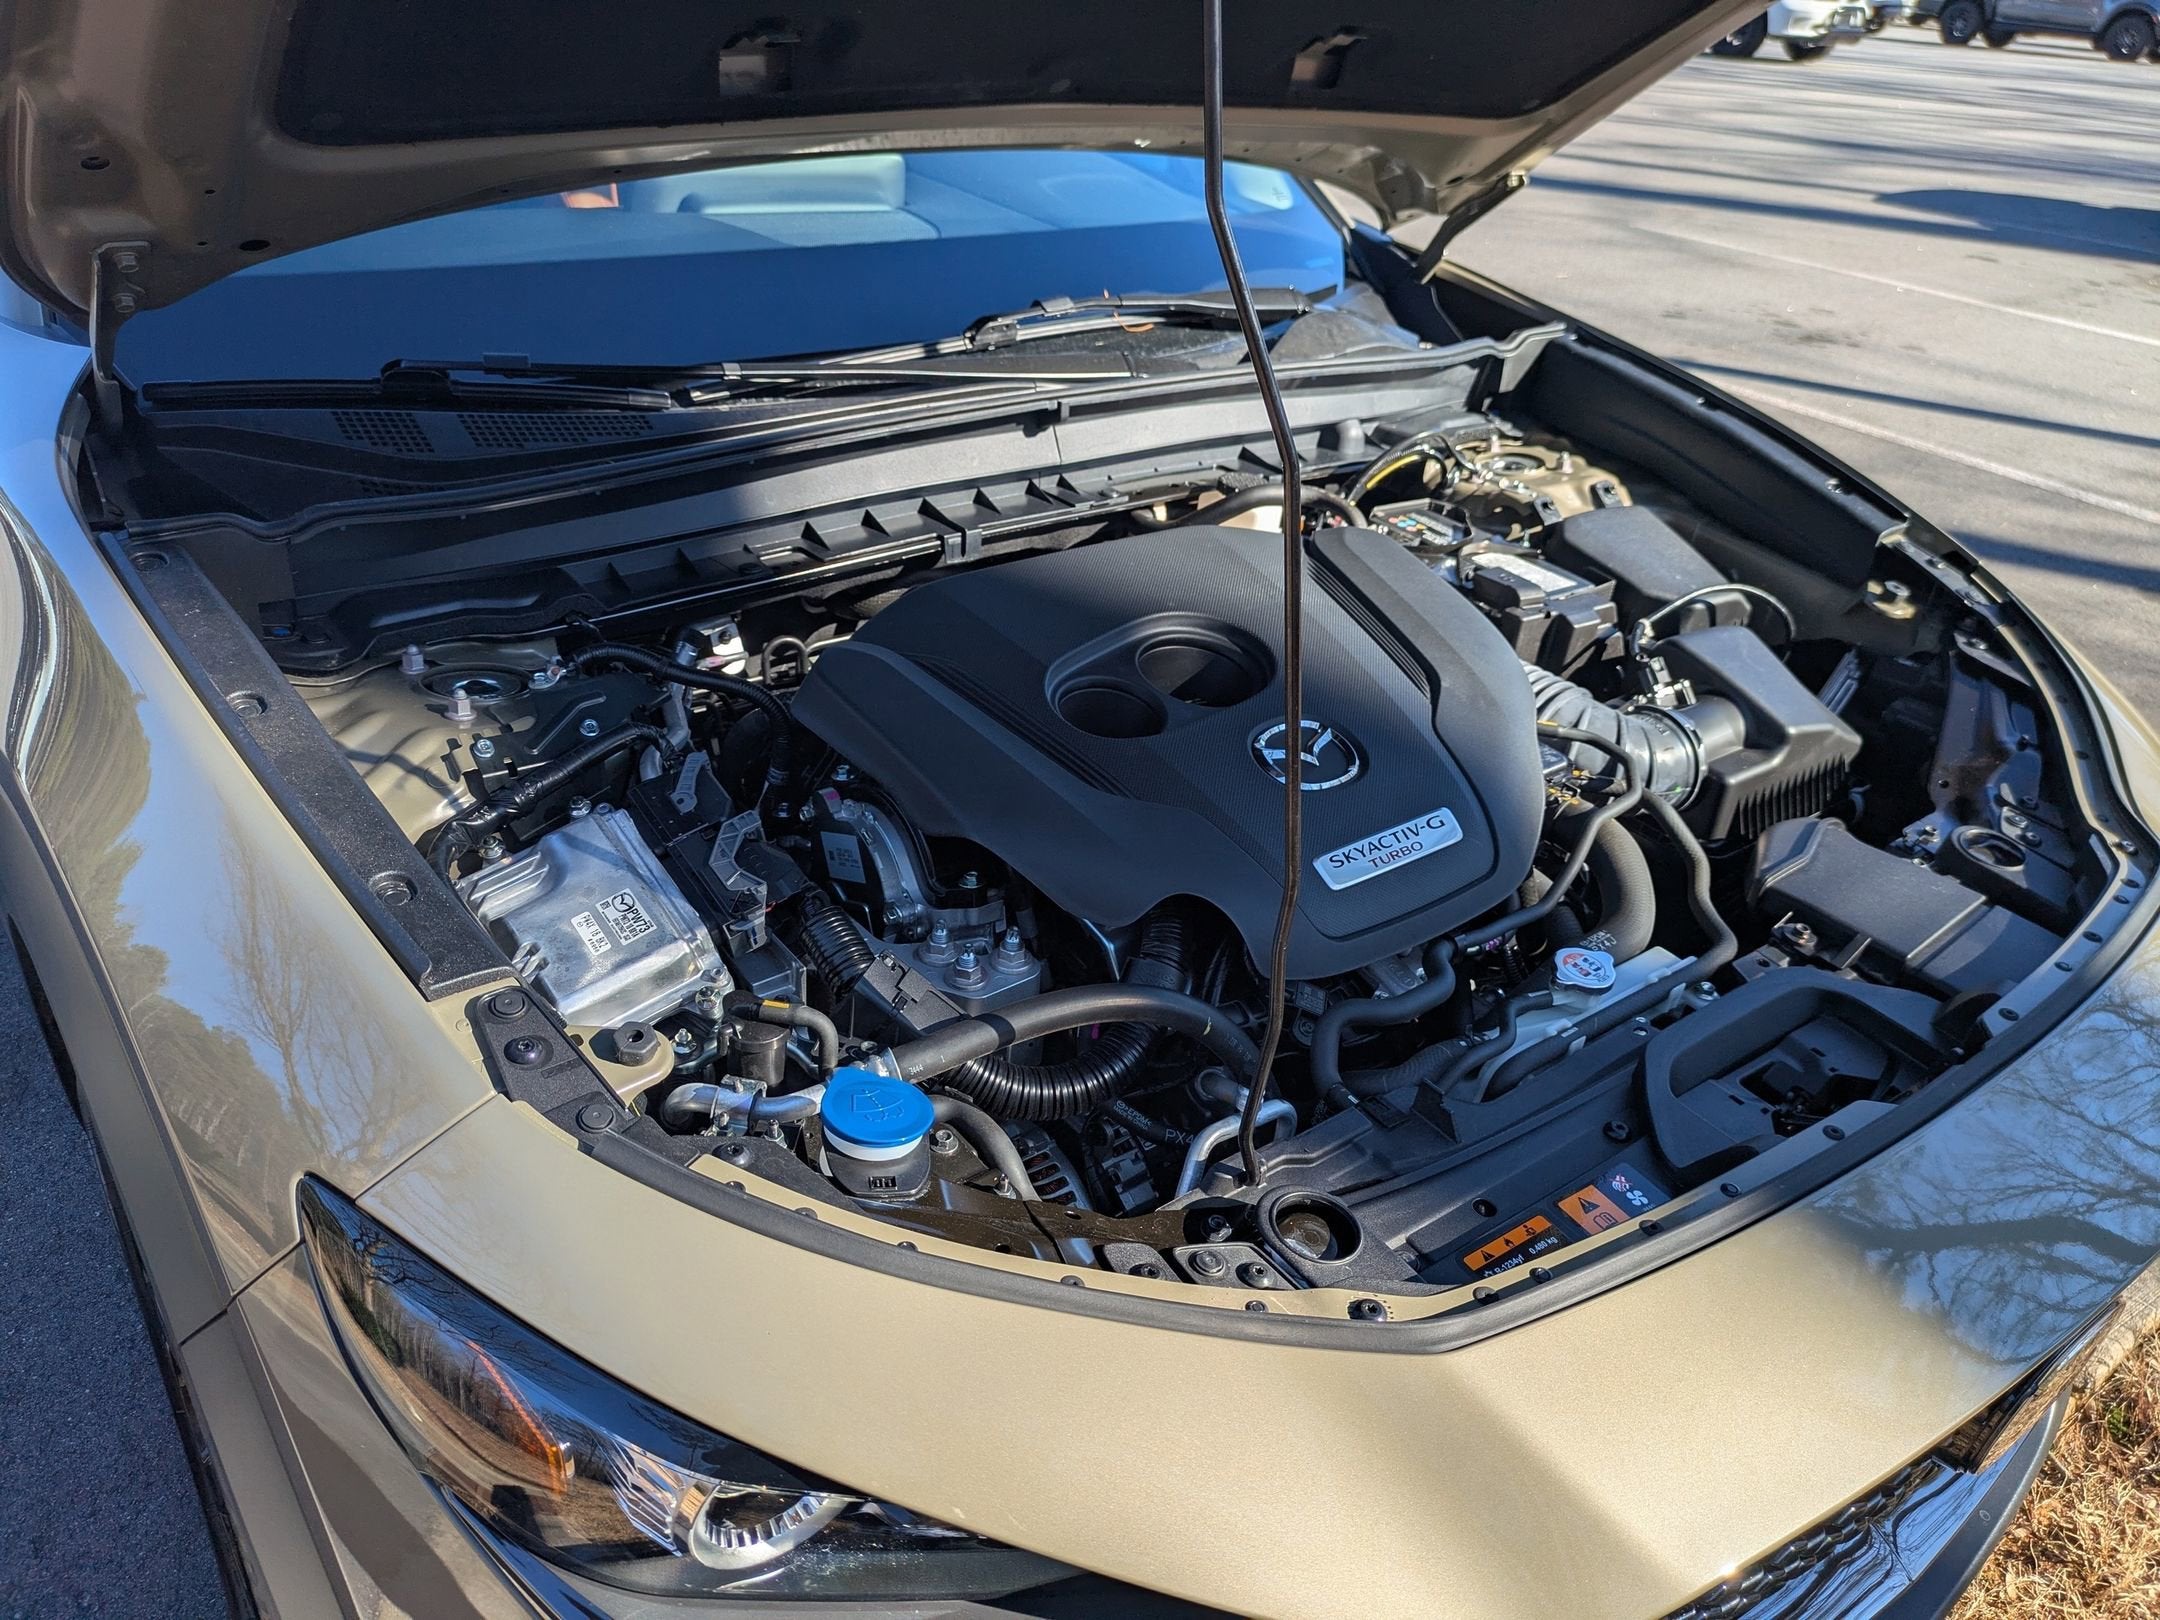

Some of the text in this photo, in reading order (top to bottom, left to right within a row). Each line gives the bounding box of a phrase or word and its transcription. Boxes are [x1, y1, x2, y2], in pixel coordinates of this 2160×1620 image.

[1328, 815, 1446, 869] SKYACTIV-G
[1368, 841, 1424, 868] TURBO
[627, 907, 651, 933] PW73
[1545, 1236, 1558, 1245] kg
